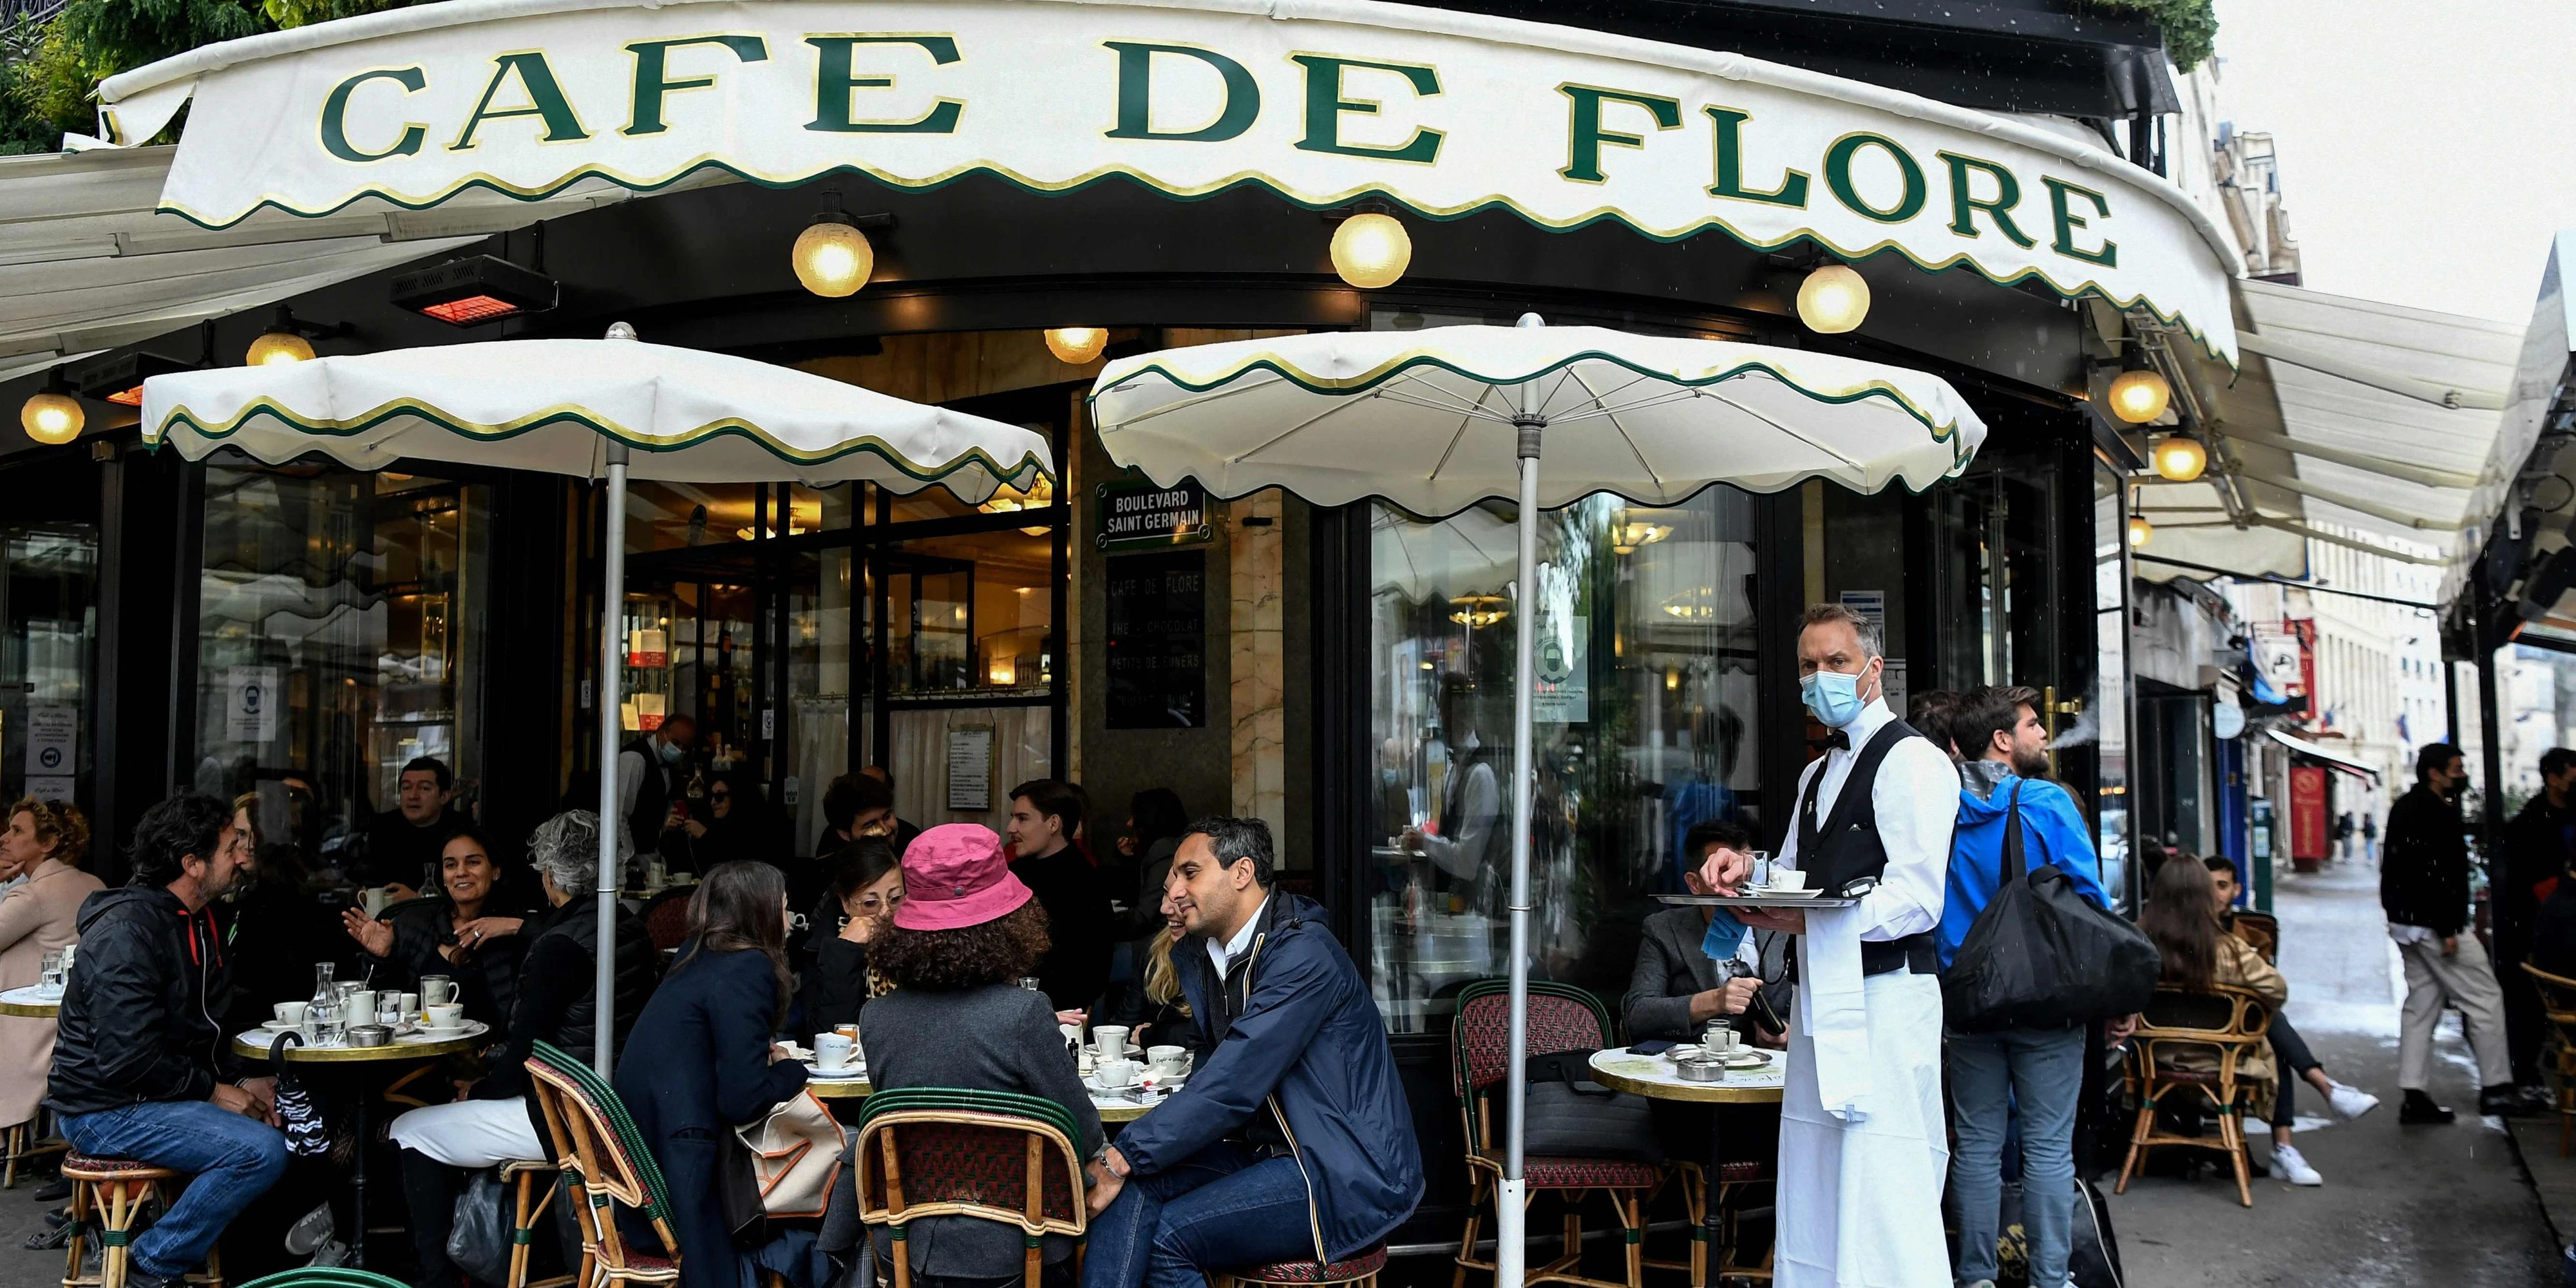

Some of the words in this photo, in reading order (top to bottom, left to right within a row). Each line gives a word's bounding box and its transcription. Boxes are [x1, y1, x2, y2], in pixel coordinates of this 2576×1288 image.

[317, 30, 968, 166] CAFE
[1097, 35, 1448, 168] DE
[1553, 80, 2119, 270] FLORE
[1115, 490, 1189, 513] BOULEVARD
[1107, 515, 1142, 533] SAINT
[1144, 509, 1200, 530] GERMAIN
[1144, 577, 1158, 595] DE
[1165, 574, 1200, 593] FLORE
[1147, 618, 1198, 633] CHOCOLAT
